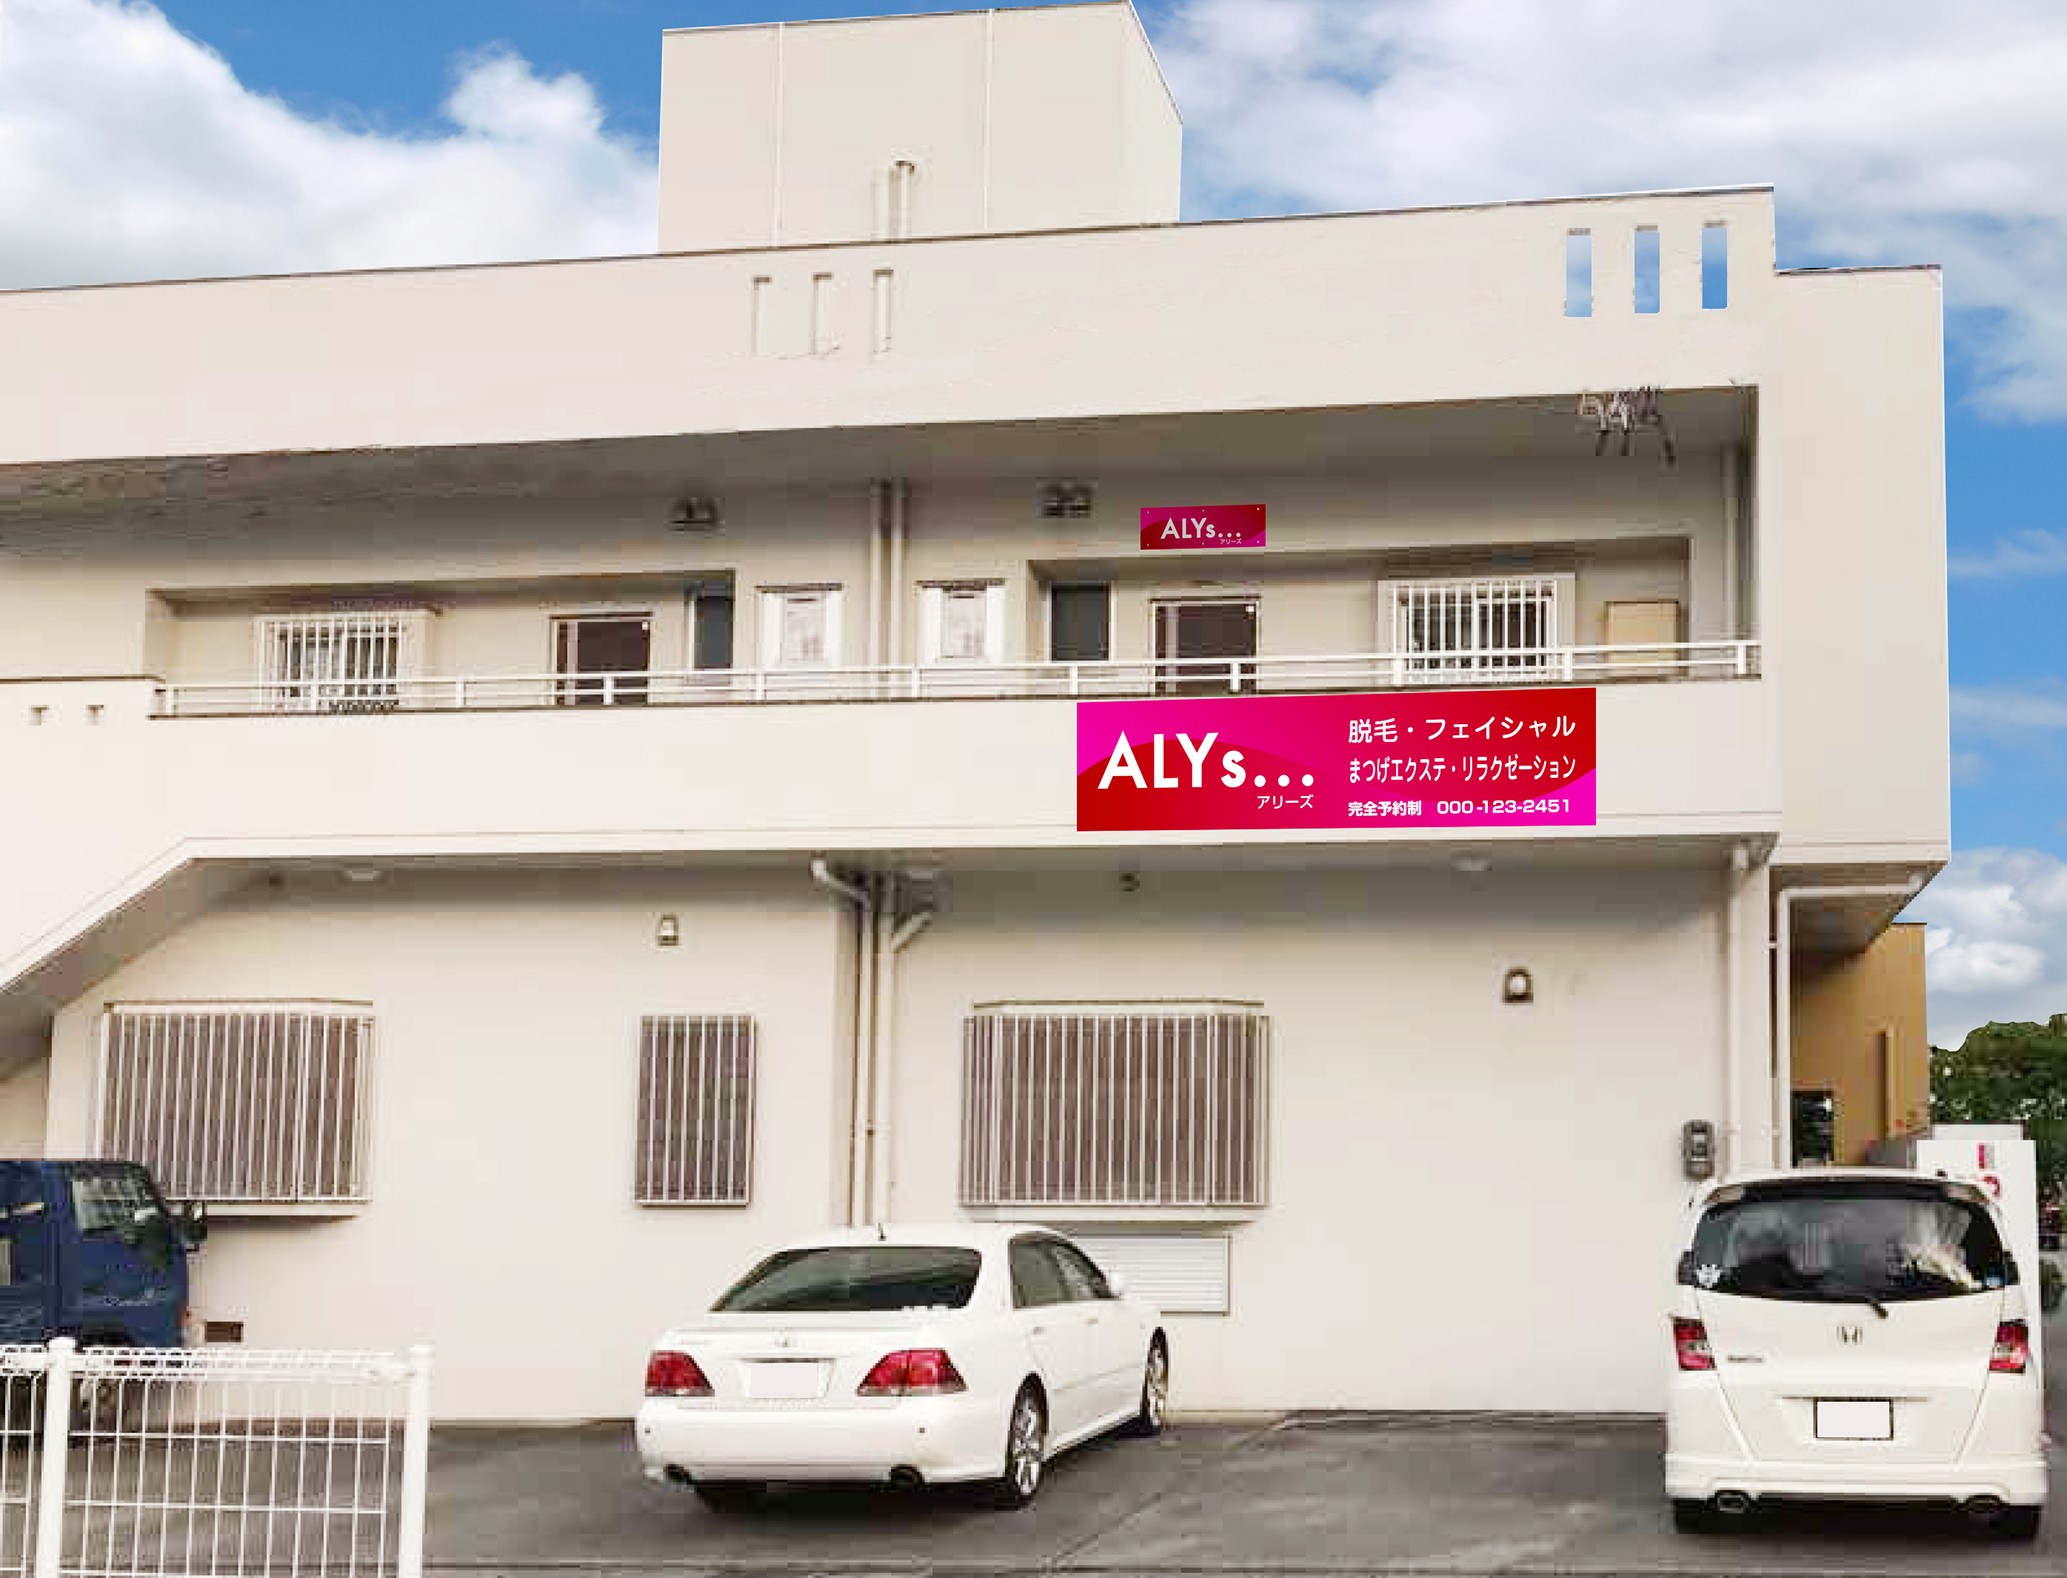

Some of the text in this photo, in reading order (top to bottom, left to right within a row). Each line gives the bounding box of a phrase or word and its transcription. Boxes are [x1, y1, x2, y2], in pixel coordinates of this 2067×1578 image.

[1348, 715, 1576, 743] 脱毛・フェイシャル
[1349, 753, 1576, 783] まつげエクステ・リラクゼーション
[1257, 794, 1314, 809] アリーズ
[1347, 801, 1422, 817] 完全予約制
